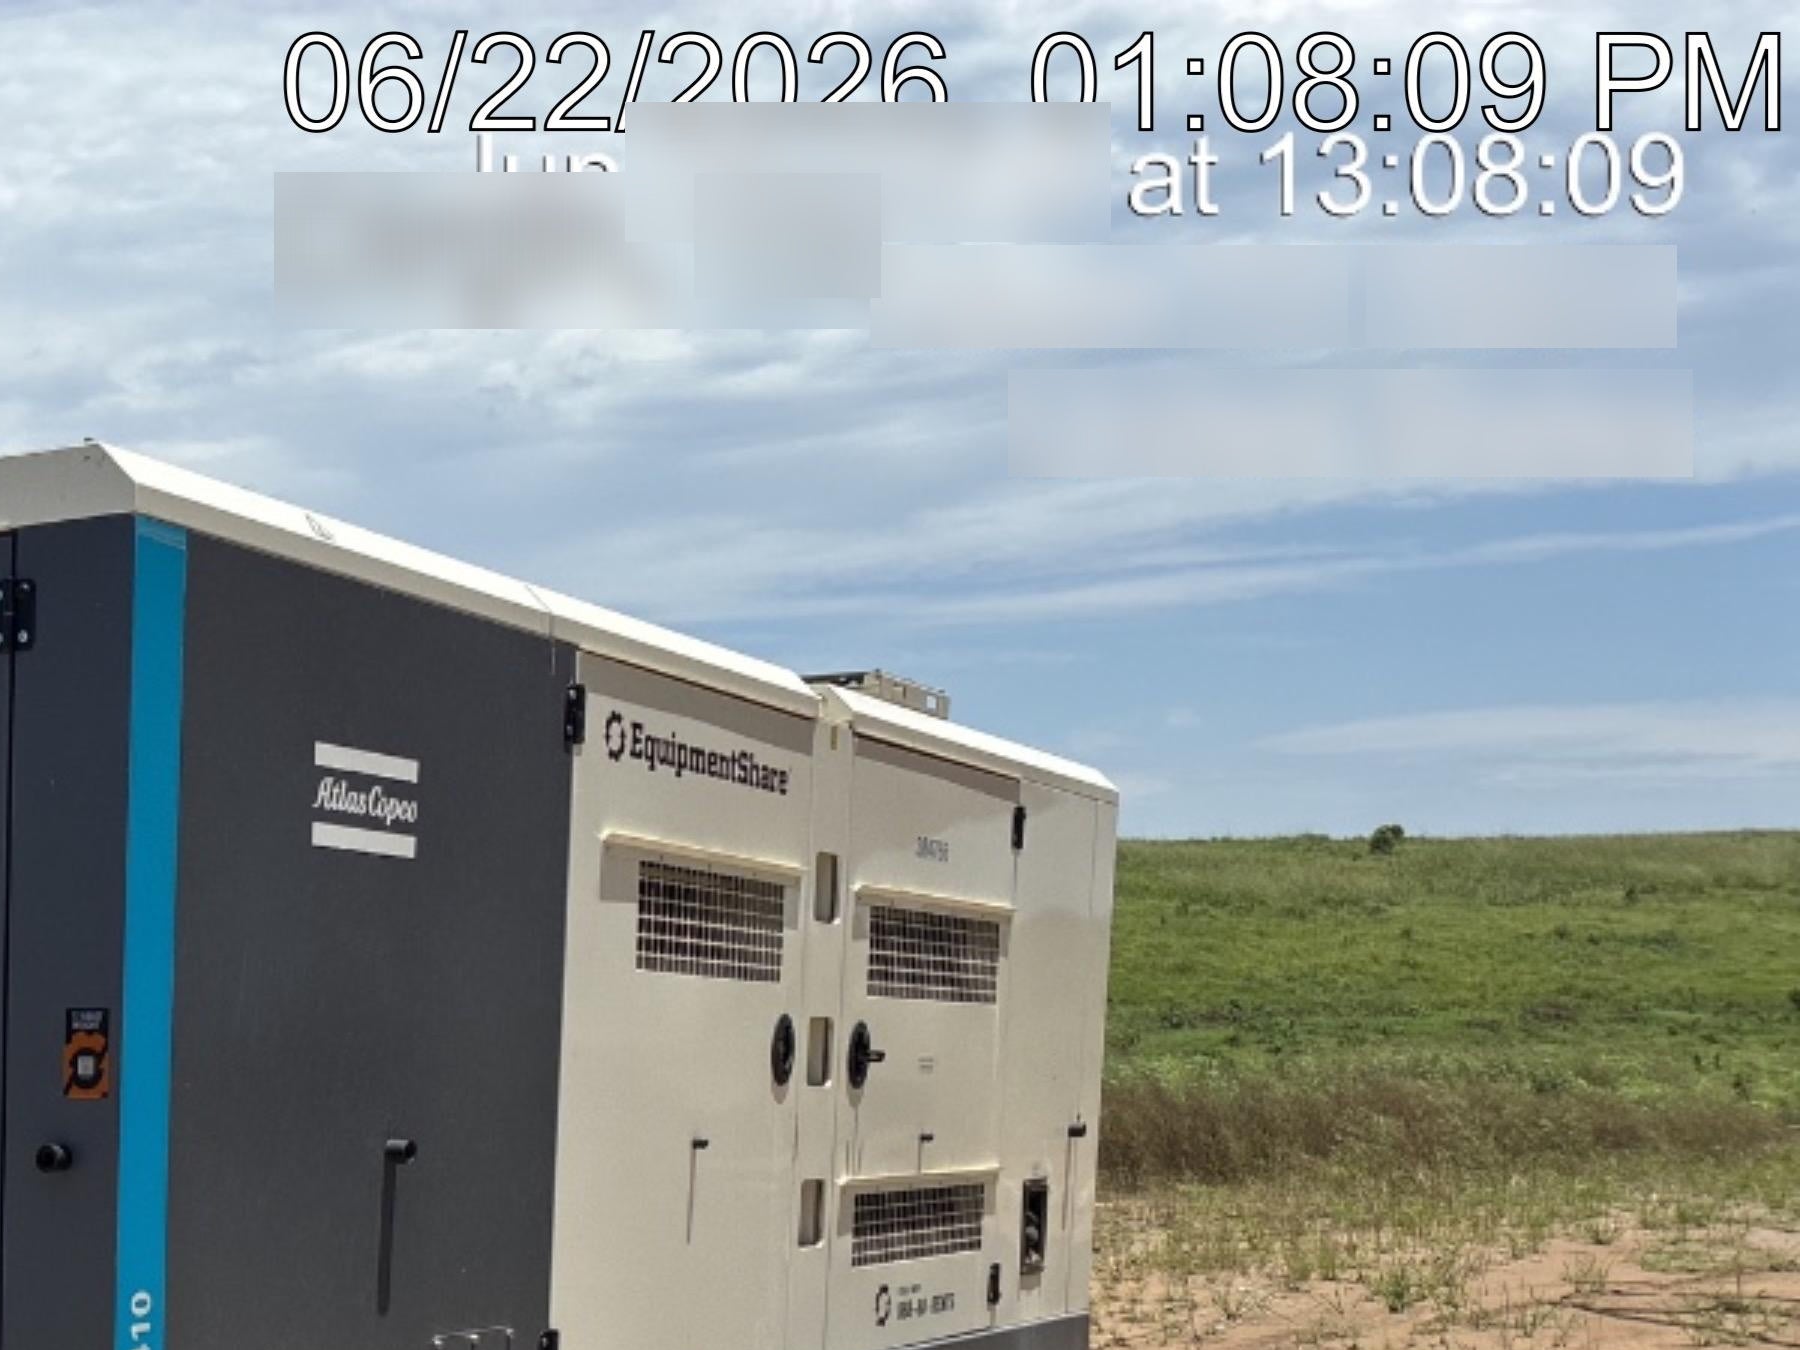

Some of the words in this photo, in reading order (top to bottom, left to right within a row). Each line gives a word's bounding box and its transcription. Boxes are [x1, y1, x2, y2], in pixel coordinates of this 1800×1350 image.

[629, 721, 790, 796] EquipmentShare
[311, 776, 367, 815] Atlas
[368, 785, 418, 826] Copco
